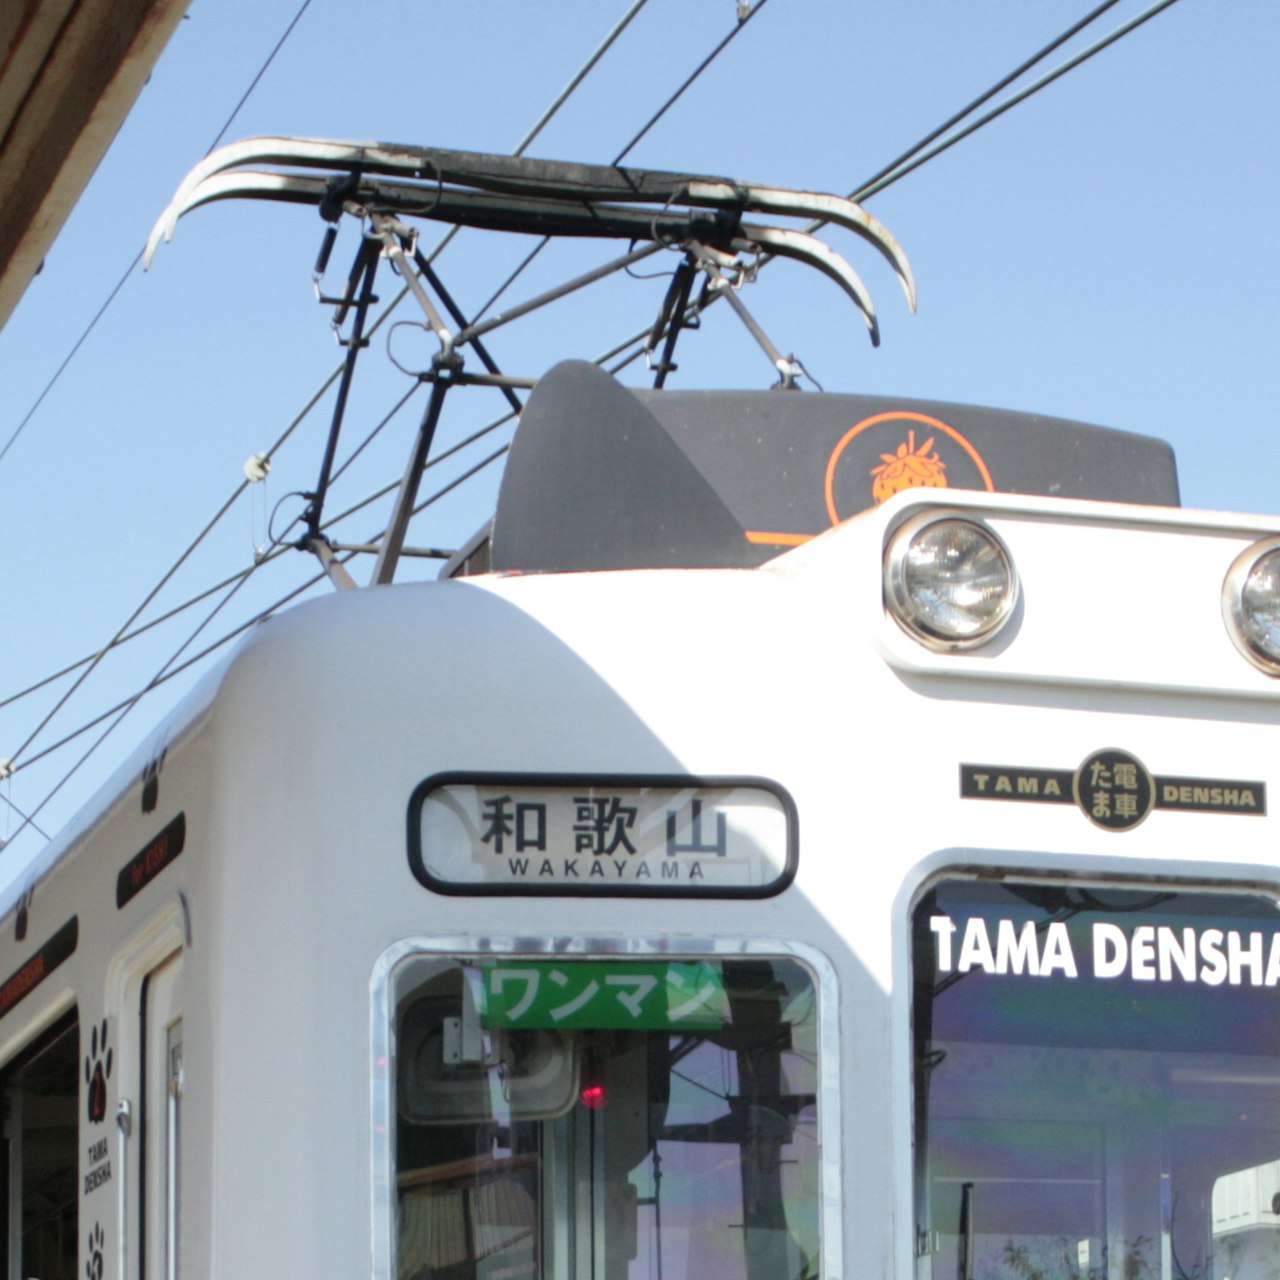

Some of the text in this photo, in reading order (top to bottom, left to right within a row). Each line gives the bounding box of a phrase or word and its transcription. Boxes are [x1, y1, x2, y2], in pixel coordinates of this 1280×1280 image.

[973, 773, 1062, 795] TAMA
[1162, 785, 1257, 807] DENSHA
[480, 796, 727, 858] 和歌山
[509, 858, 705, 880] WAKAYAMA
[929, 915, 1078, 979] TAMA
[490, 967, 718, 1023] ワンマン
